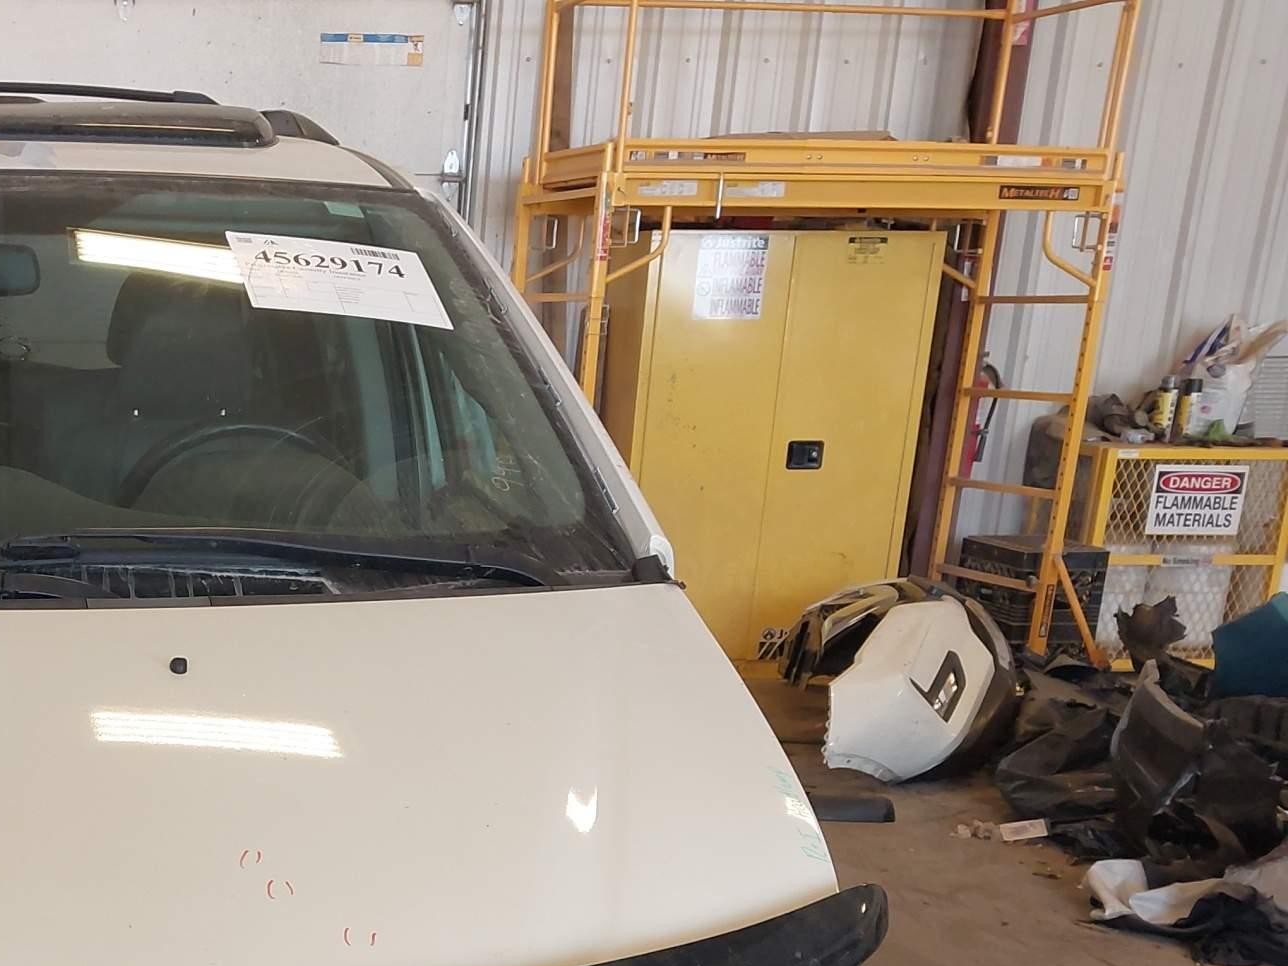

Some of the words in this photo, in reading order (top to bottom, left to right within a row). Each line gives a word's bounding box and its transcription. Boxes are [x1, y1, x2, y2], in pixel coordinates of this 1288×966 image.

[254, 250, 406, 278] 45629174
[1168, 476, 1232, 489] DANGER
[1154, 495, 1239, 511] FLAMMABLE
[1154, 512, 1232, 528] MATERIALS
